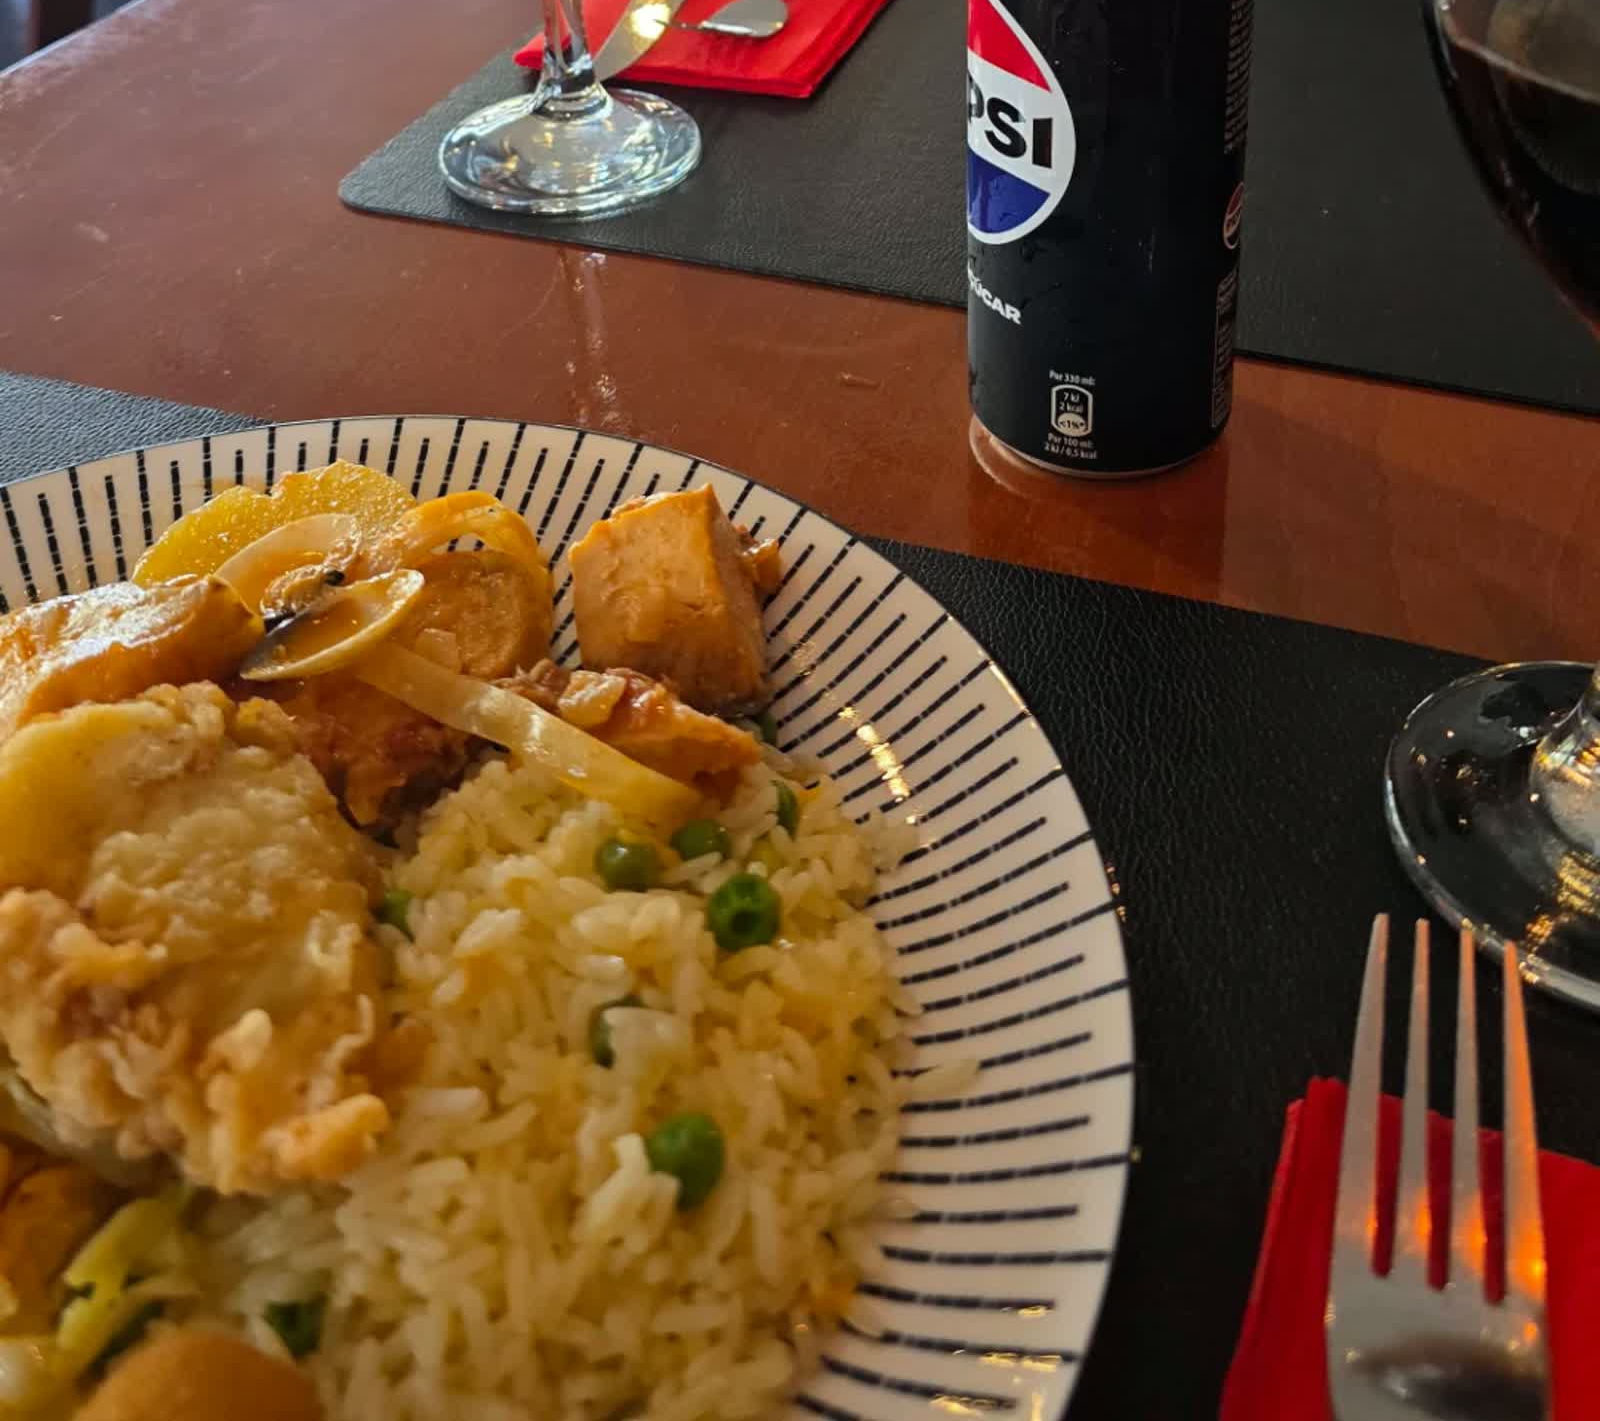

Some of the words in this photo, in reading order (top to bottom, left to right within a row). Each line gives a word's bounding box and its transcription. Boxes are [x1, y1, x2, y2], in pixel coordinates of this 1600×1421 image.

[1064, 372, 1080, 384] 330
[1063, 391, 1069, 401] 7
[1059, 402, 1065, 411] 2
[1066, 403, 1084, 413] kcal
